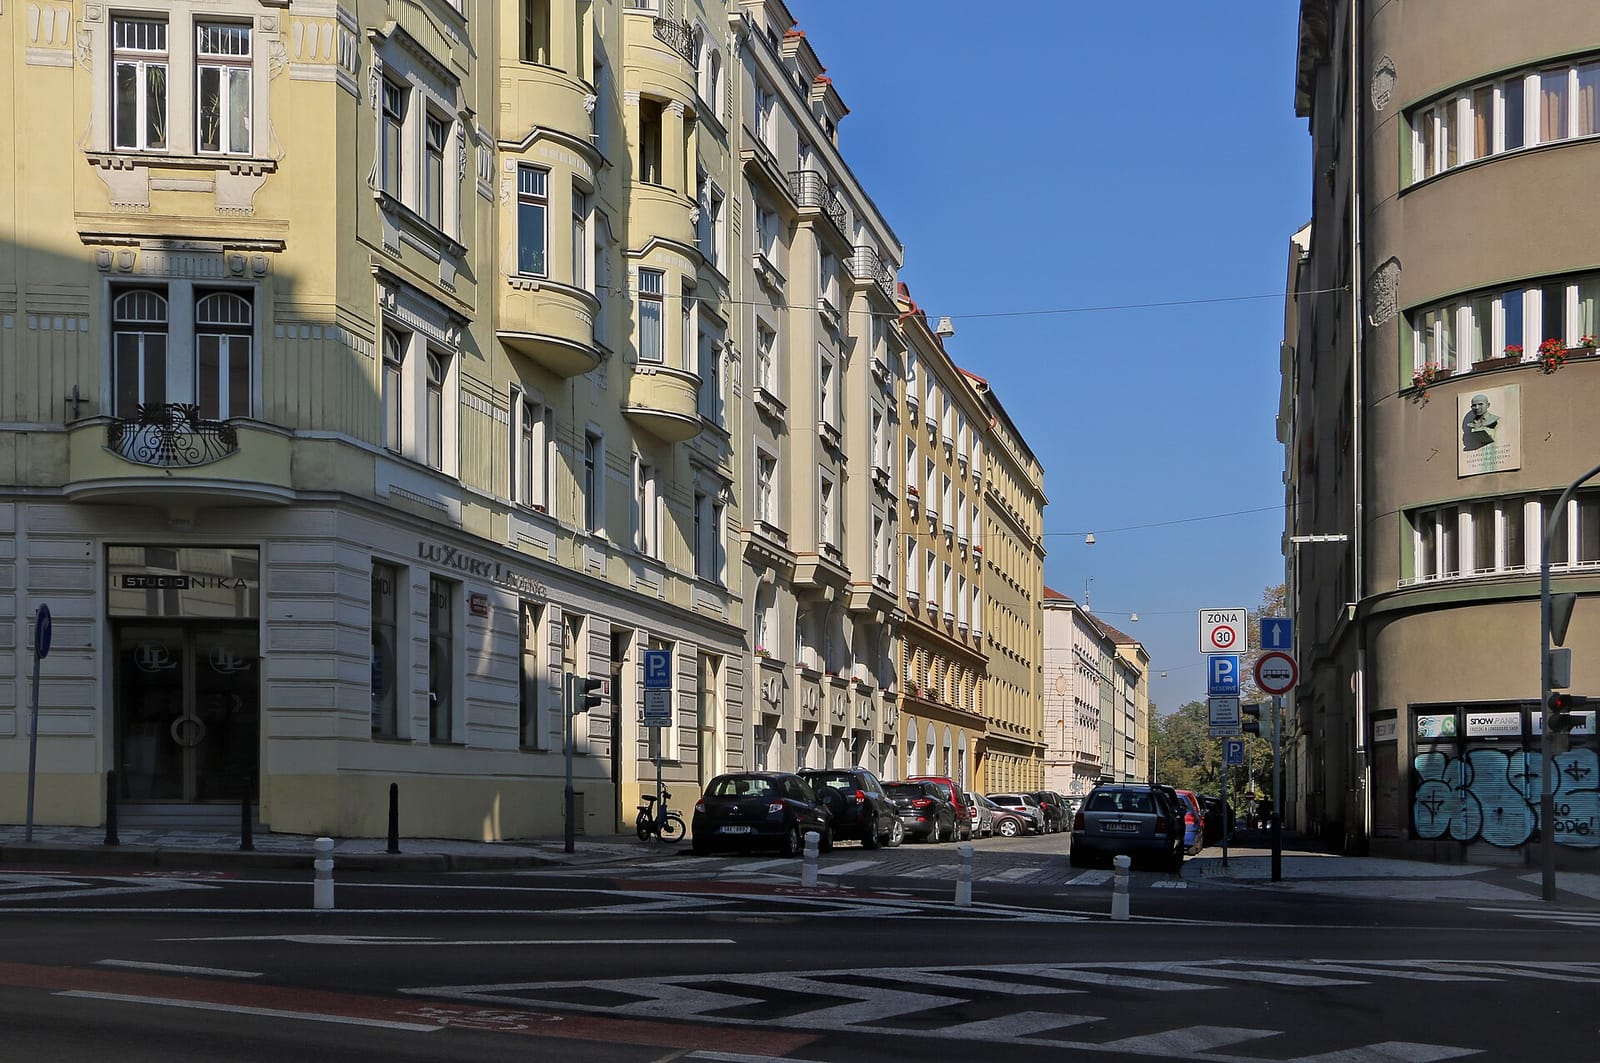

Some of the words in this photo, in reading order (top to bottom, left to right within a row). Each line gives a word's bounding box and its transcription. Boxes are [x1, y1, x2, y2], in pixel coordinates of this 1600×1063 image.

[126, 577, 185, 587] STUDIO
[191, 577, 247, 588] NIKA
[1216, 631, 1230, 643] 30
[649, 654, 666, 677] P
[1214, 660, 1233, 683] P
